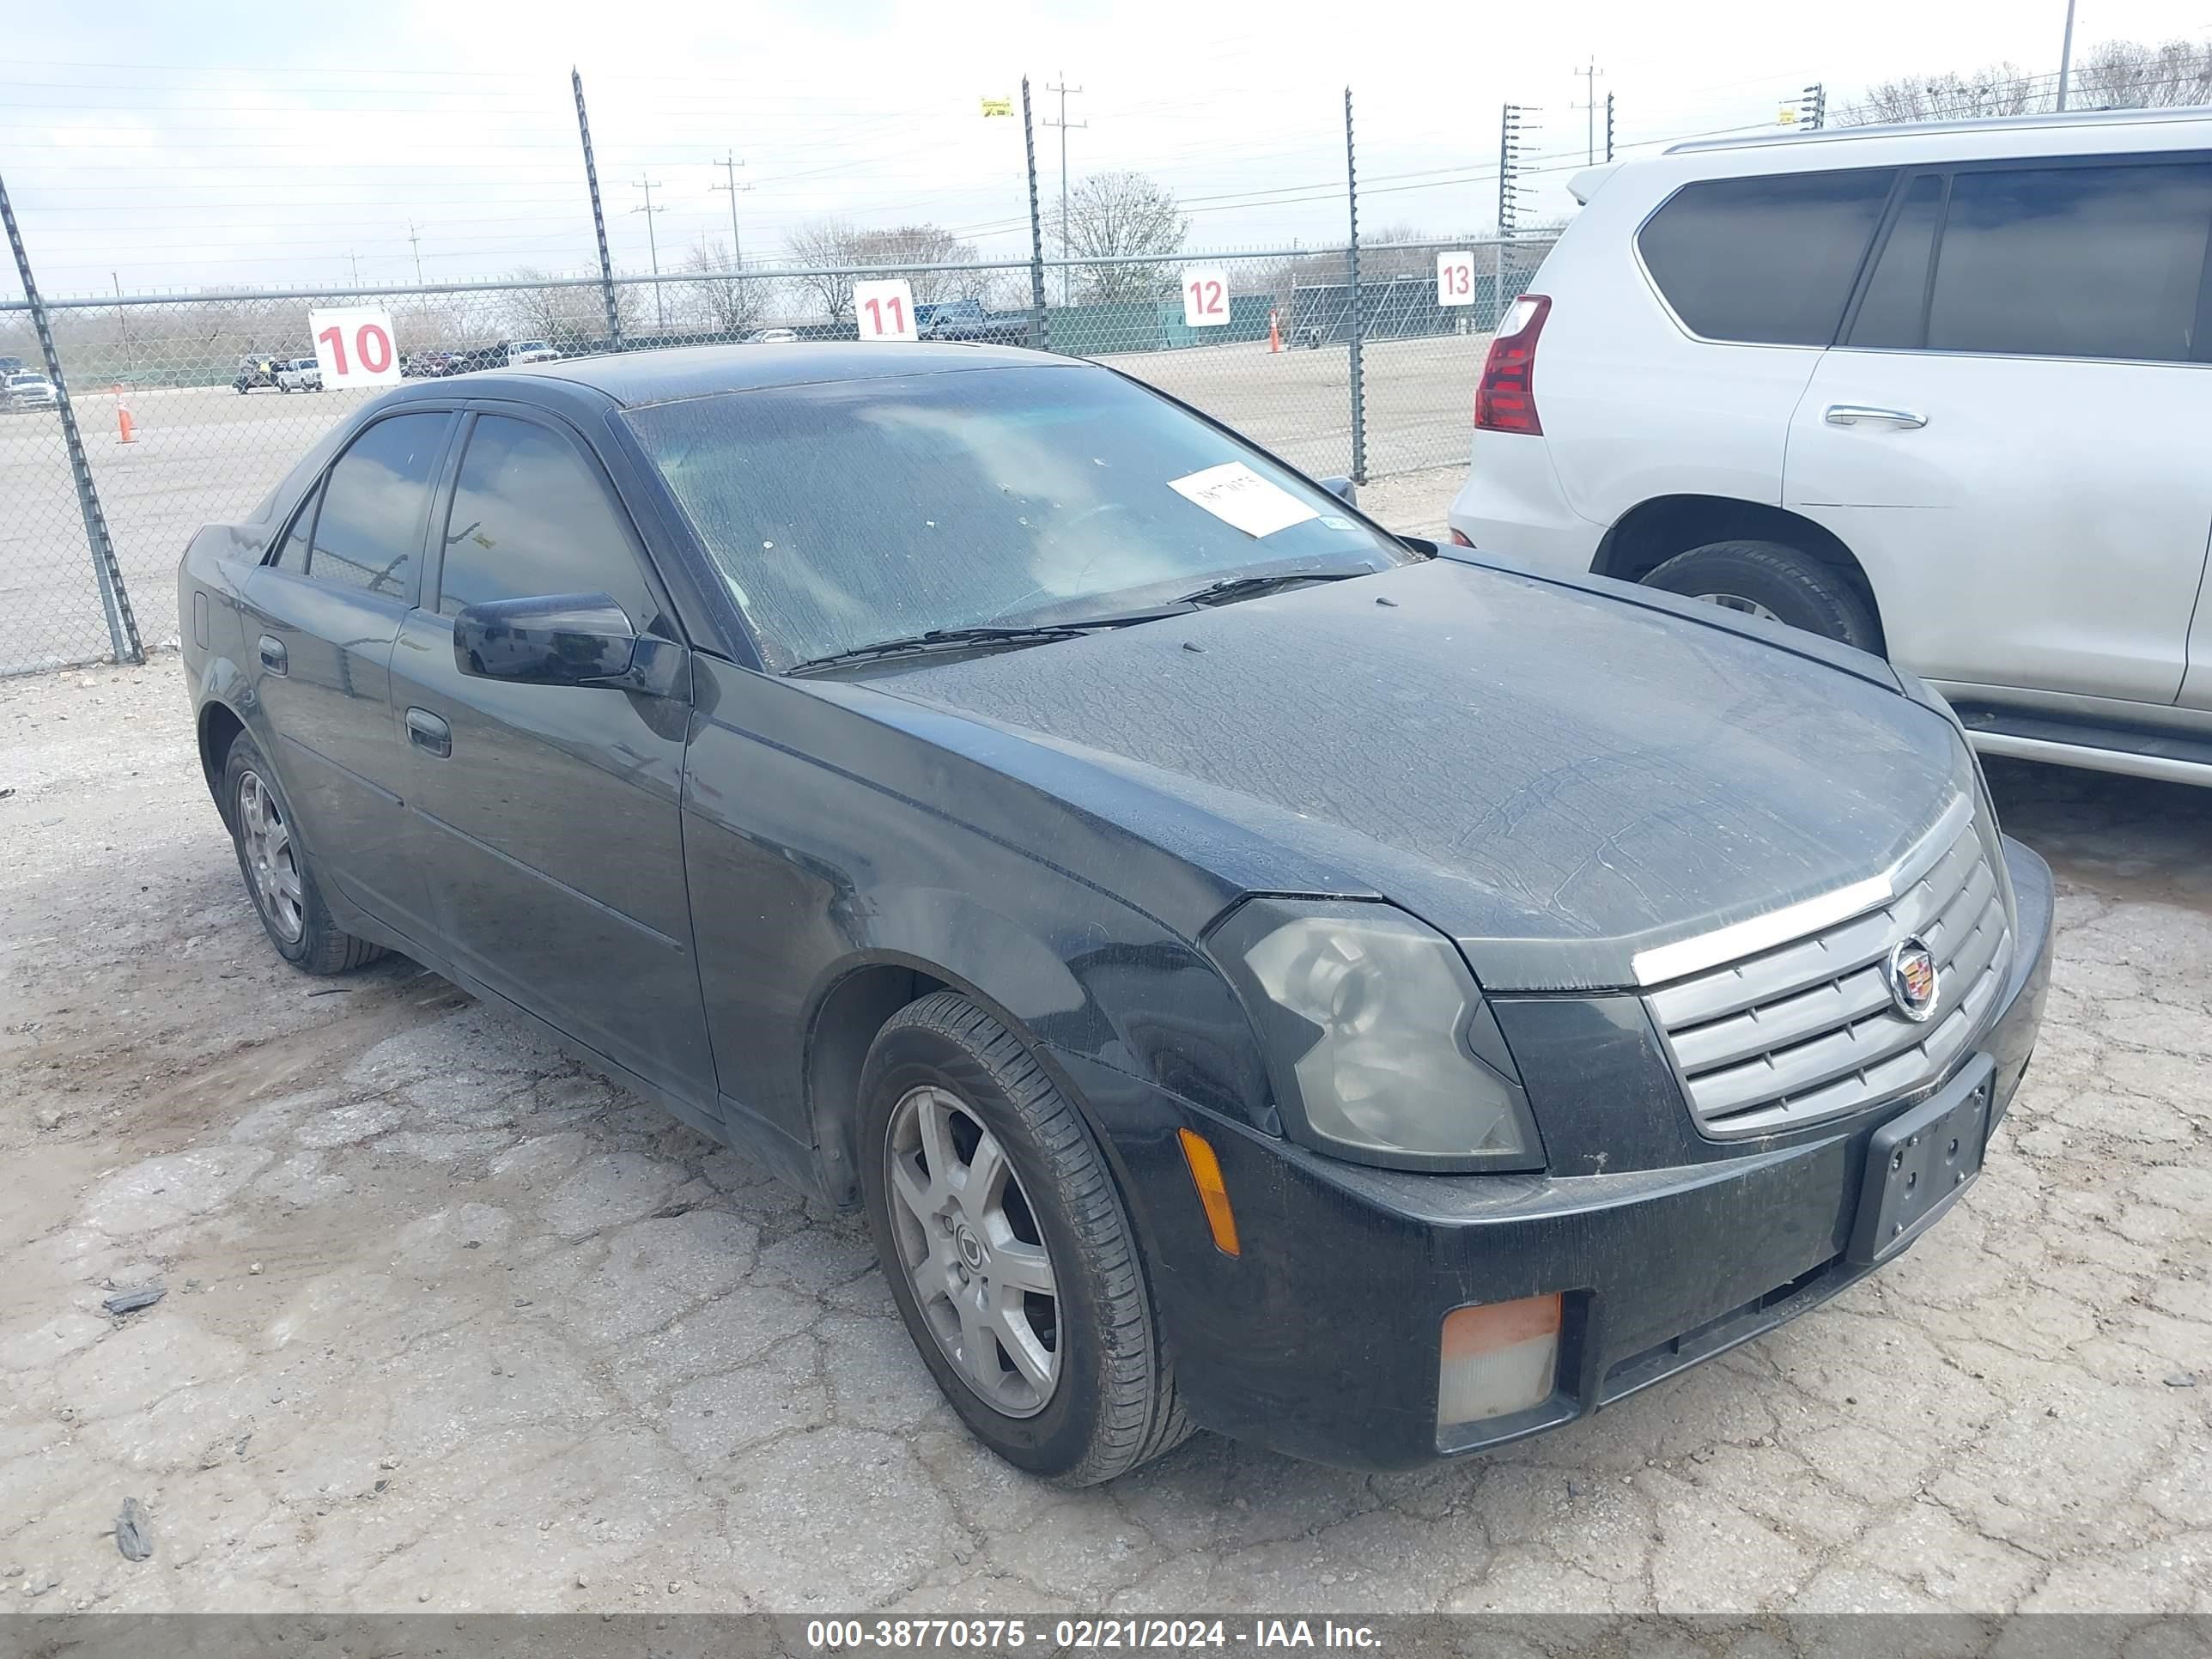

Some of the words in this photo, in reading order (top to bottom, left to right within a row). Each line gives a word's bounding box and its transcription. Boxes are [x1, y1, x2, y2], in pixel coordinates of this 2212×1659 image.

[1190, 281, 1224, 314] 12
[1443, 264, 1469, 295] 13
[865, 296, 905, 335] 11
[319, 324, 392, 375] 10
